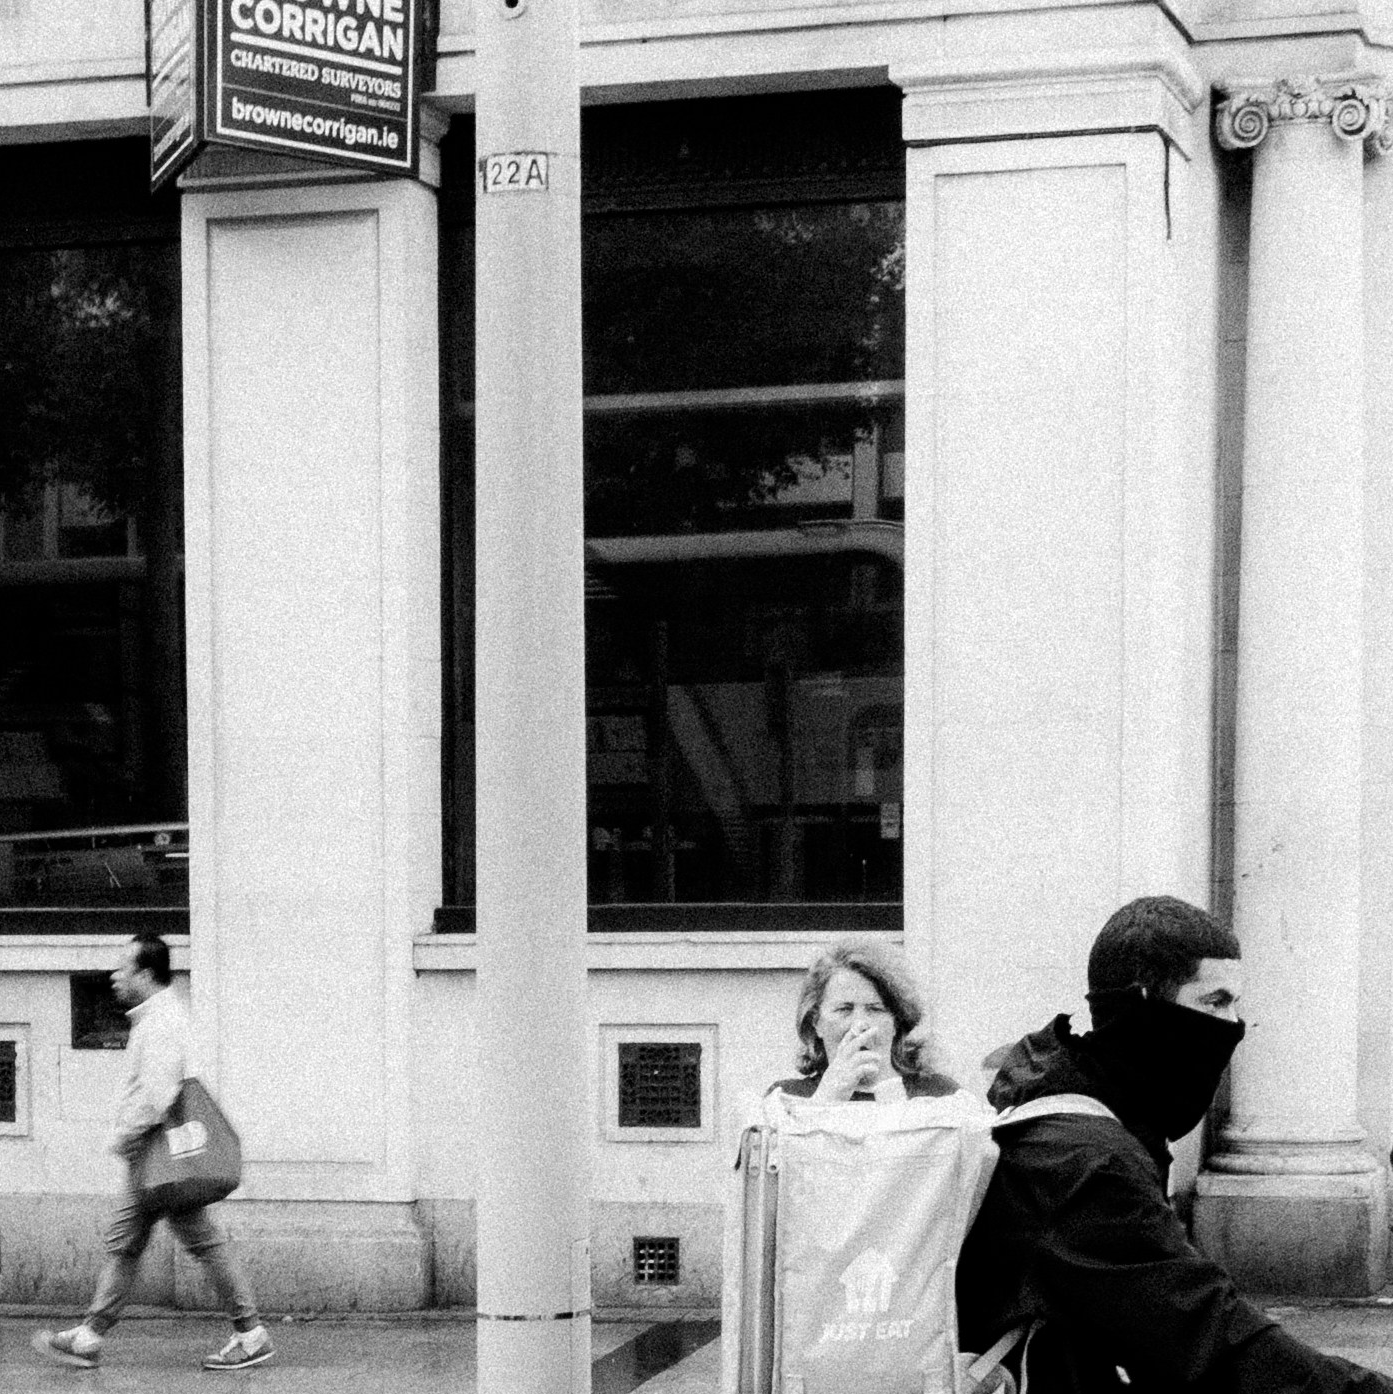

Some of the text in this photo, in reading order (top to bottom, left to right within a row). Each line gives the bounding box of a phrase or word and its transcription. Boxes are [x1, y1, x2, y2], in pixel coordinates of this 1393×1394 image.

[230, 0, 403, 61] CORRIGAN
[230, 49, 402, 99] CHARTERED SURVEYORS
[232, 97, 399, 149] brownecorrigan.ie
[491, 158, 544, 186] 22A
[819, 1318, 915, 1343] JUST EAT
